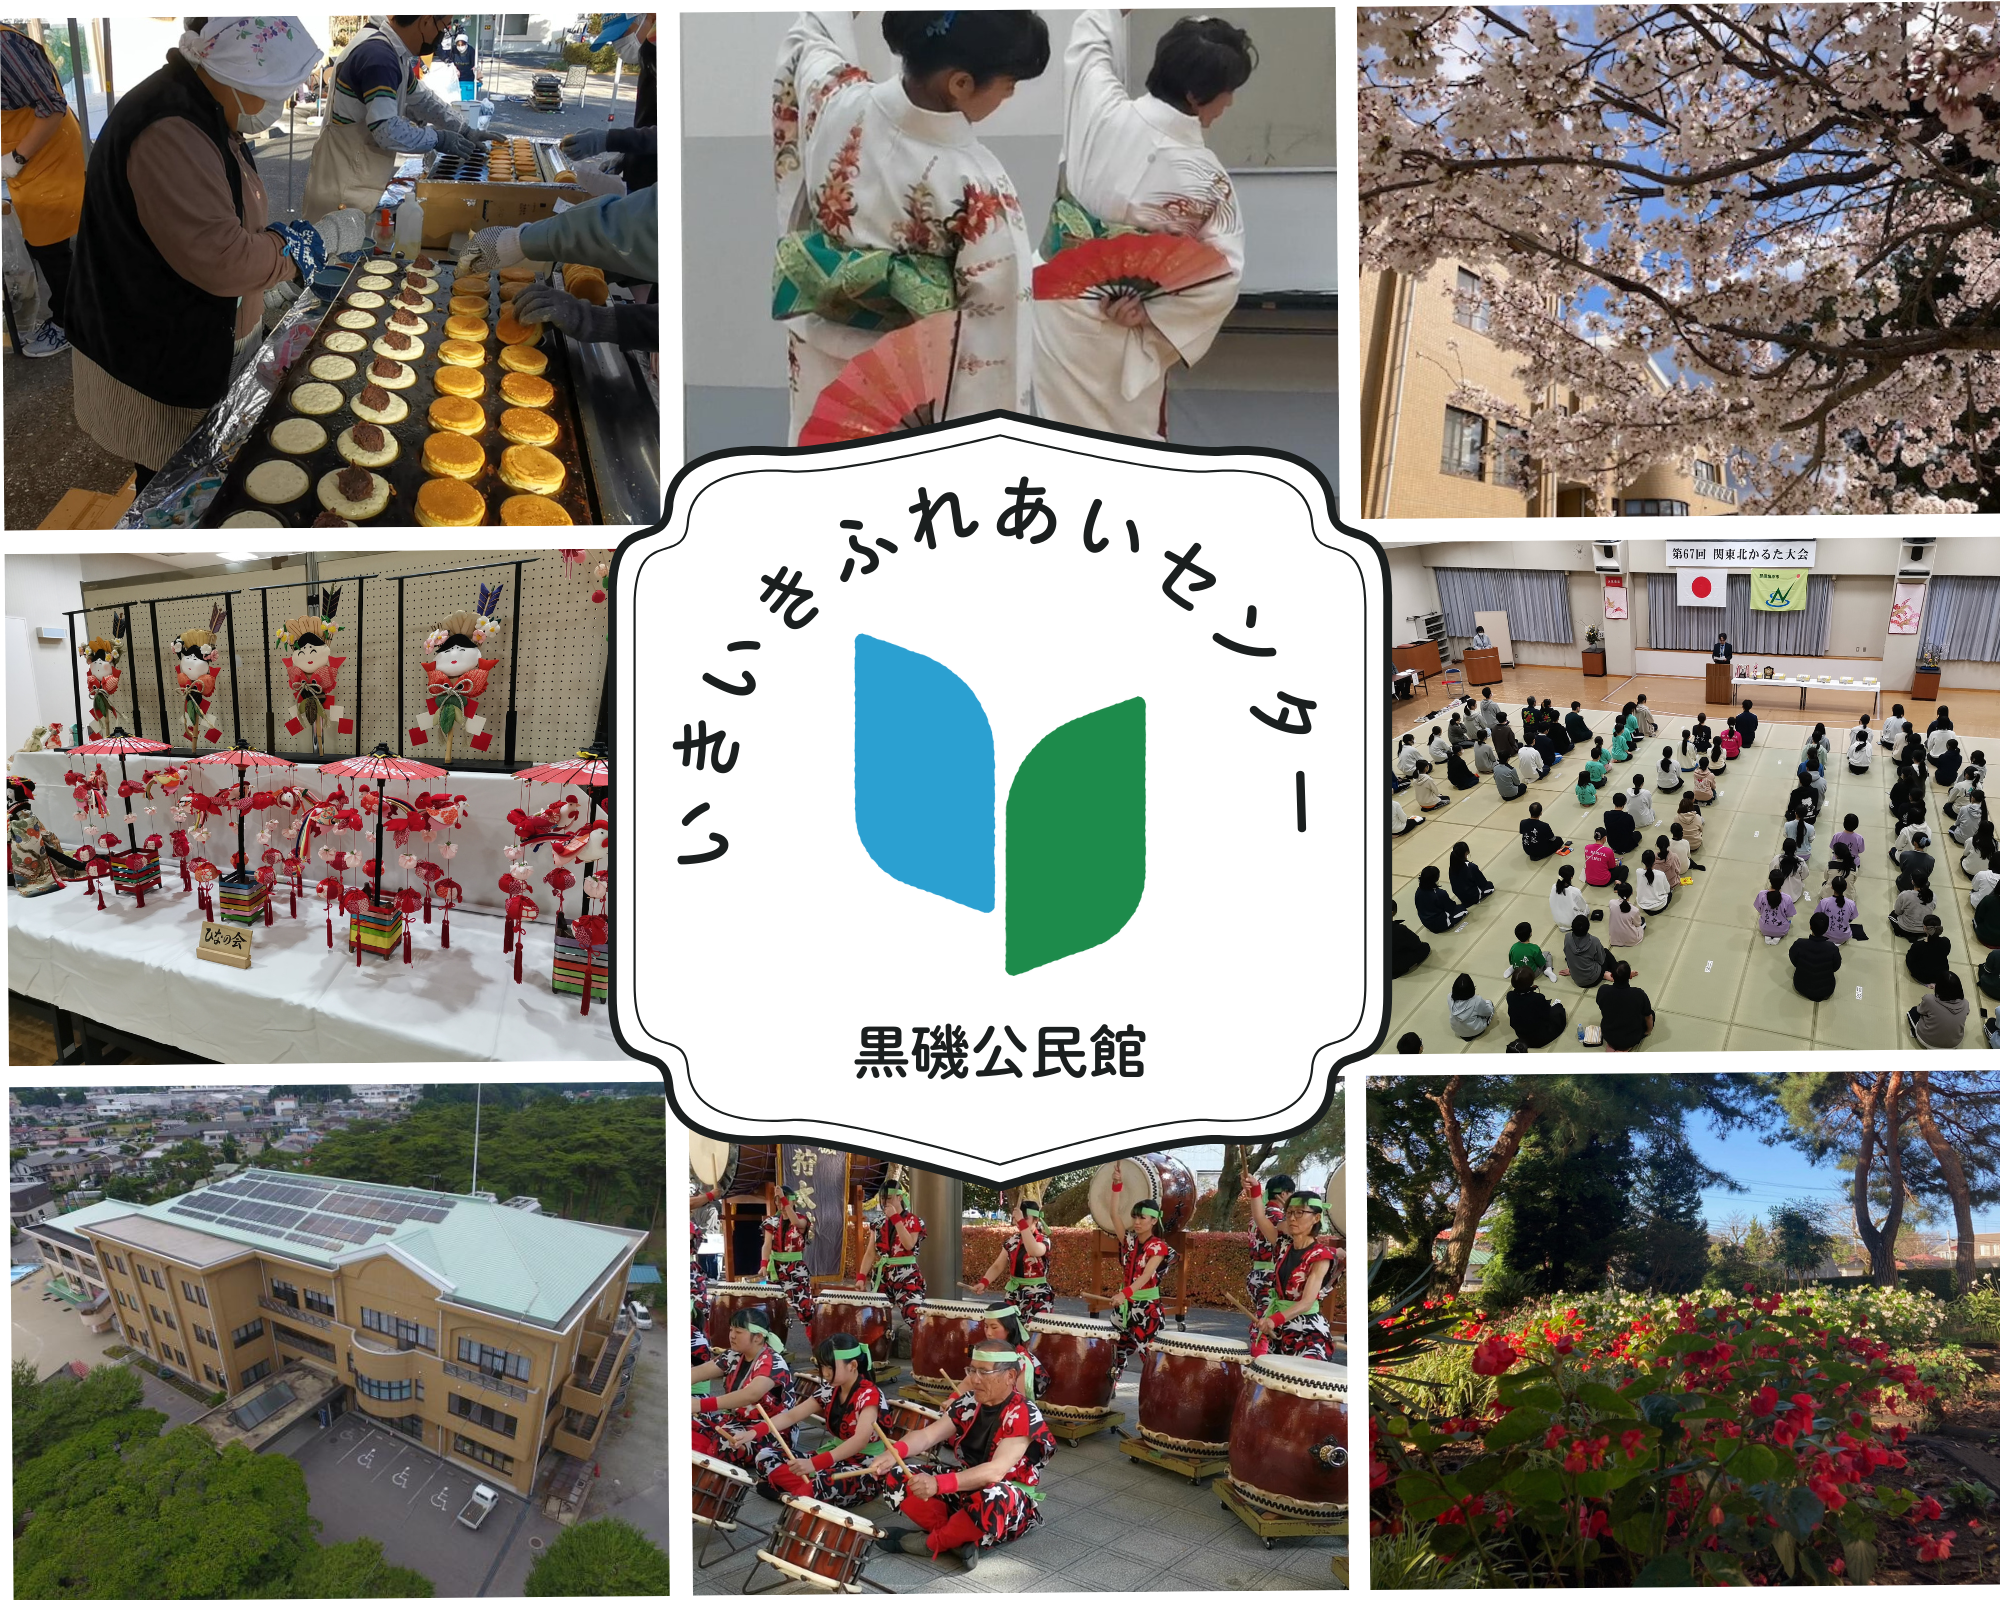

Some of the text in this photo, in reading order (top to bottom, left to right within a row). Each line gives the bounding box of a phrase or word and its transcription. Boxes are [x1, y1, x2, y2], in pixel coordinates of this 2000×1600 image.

[1672, 548, 1809, 560] 第67回 関東北かるた大会
[204, 927, 247, 950] ひなの会
